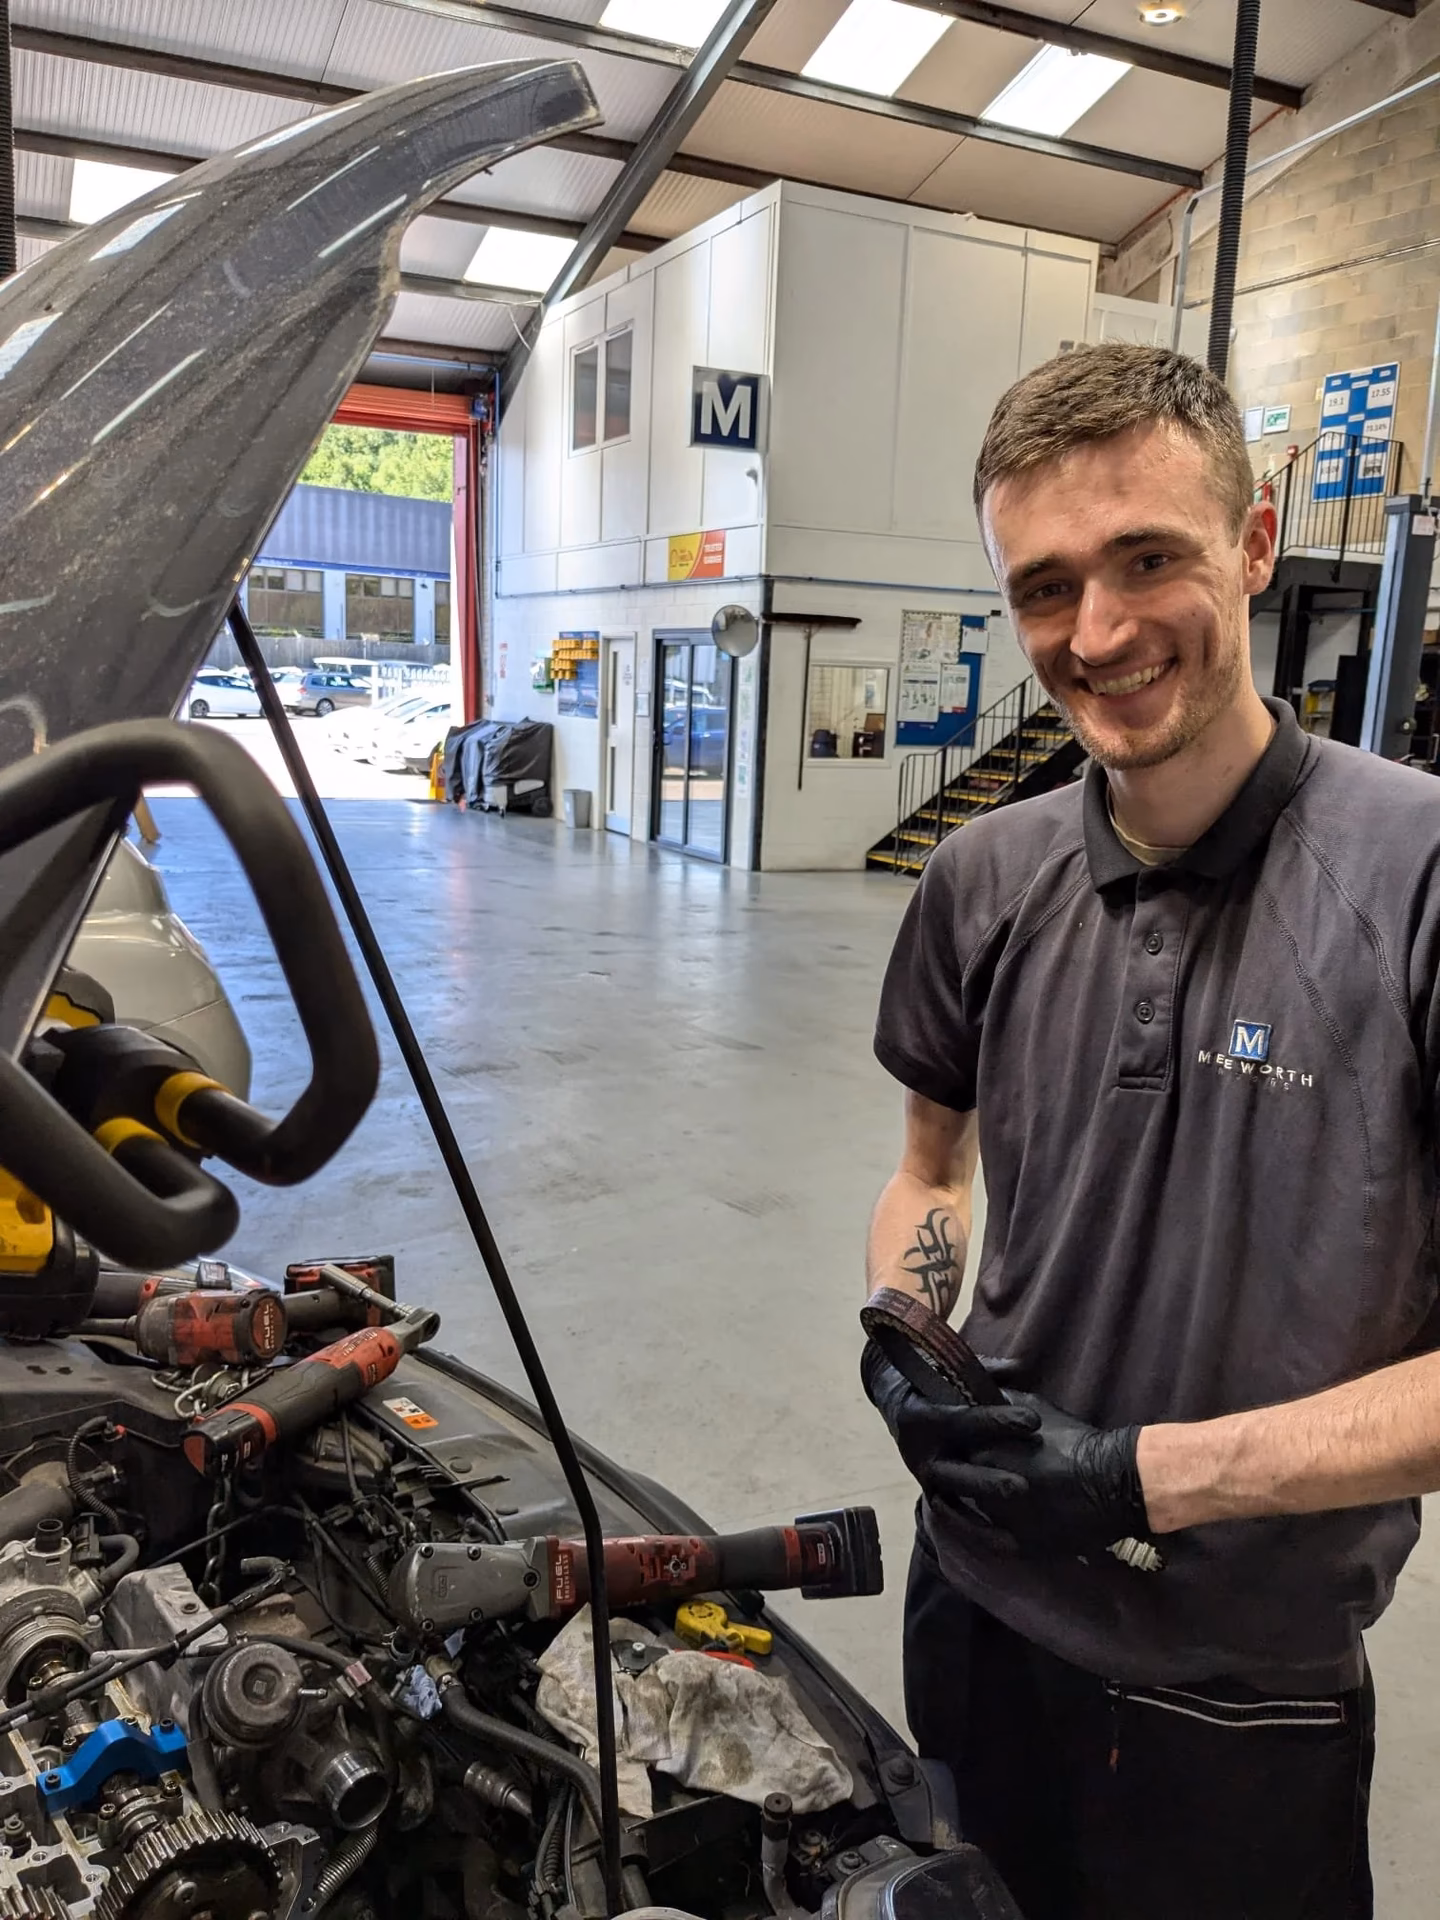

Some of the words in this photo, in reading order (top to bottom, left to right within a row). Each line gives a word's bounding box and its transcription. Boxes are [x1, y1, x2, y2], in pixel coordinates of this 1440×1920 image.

[700, 380, 752, 439] M
[1234, 1026, 1266, 1055] M
[555, 1553, 563, 1600] FUEL
